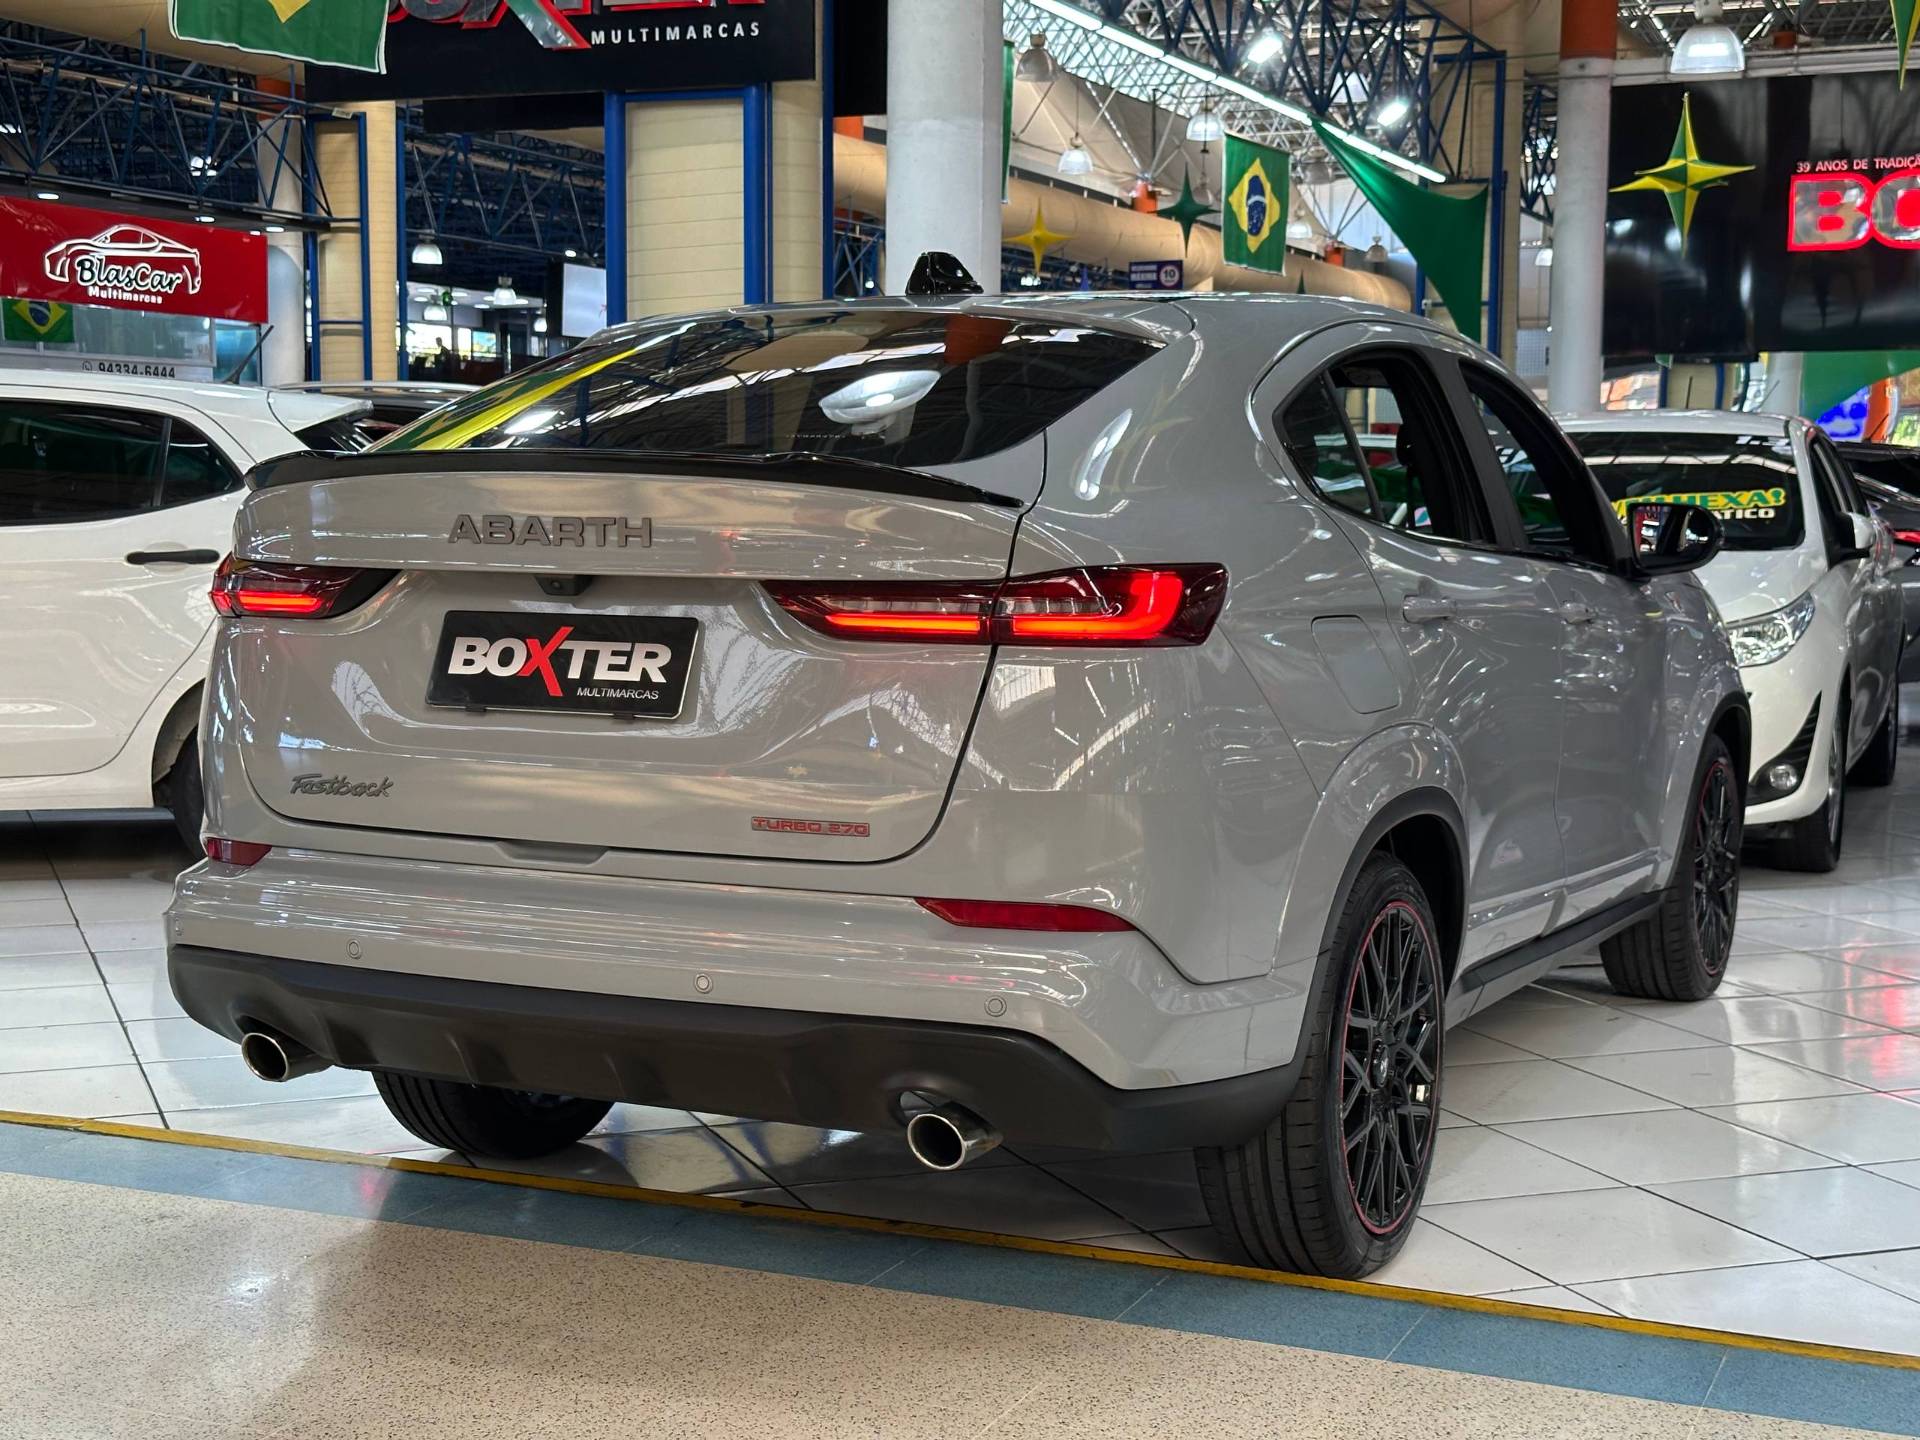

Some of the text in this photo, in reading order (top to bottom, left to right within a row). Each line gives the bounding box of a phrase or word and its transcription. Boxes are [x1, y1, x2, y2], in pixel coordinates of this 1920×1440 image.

[591, 21, 760, 46] MULTIMARCAS
[1796, 161, 1810, 173] 39
[1815, 160, 1848, 172] ANOS
[1853, 158, 1868, 170] DE
[75, 252, 183, 294] BlasCar
[88, 285, 163, 304] Multimarcas
[448, 514, 652, 548] ABARTH
[447, 626, 672, 697] BOXTER
[576, 686, 660, 700] MULTIMARCAS
[290, 773, 394, 797] Fastback
[752, 817, 869, 835] TURBO 270
